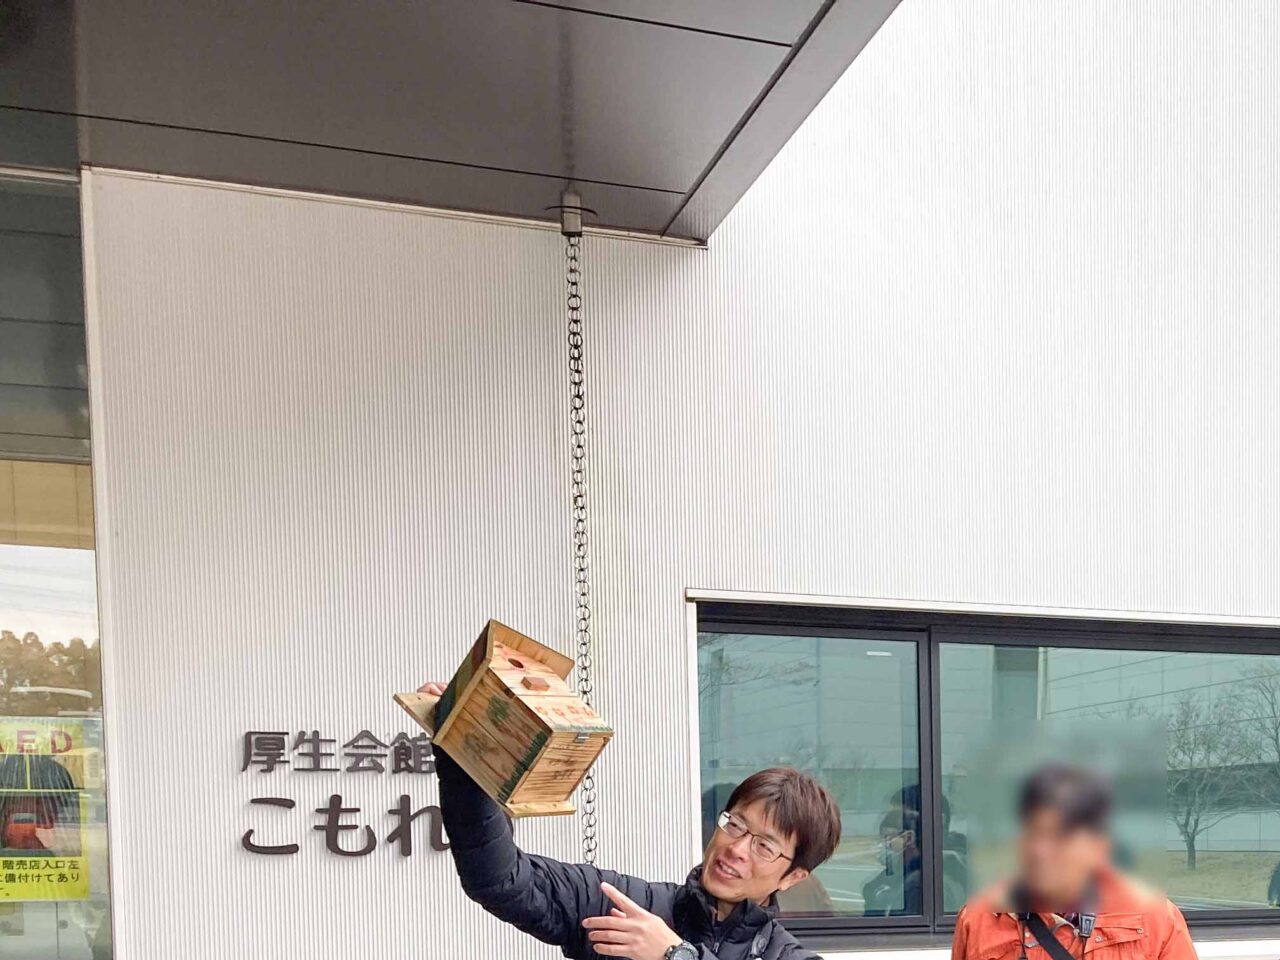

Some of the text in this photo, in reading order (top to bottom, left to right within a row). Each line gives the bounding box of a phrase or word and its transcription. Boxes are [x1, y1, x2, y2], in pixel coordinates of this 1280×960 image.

[0, 730, 73, 754] ED
[242, 730, 436, 774] 厚生会館
[242, 794, 452, 857] こもれ
